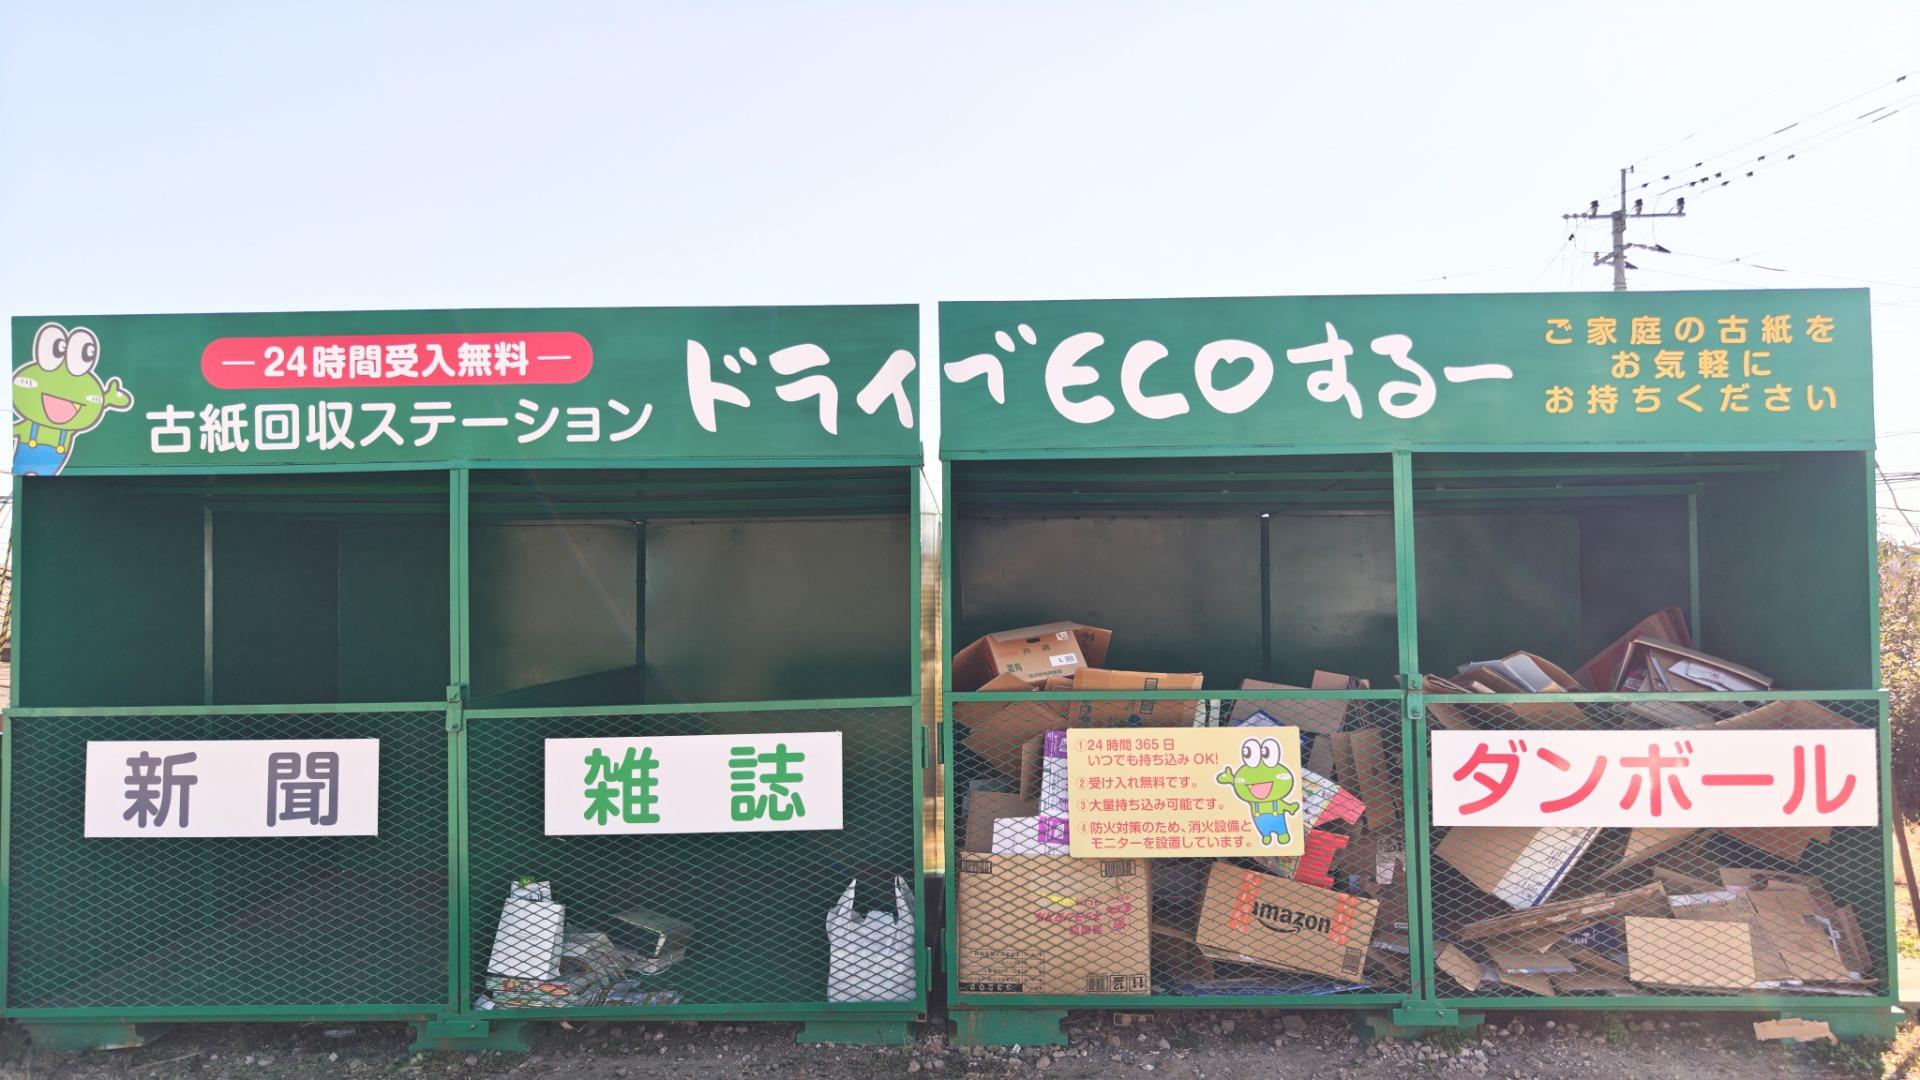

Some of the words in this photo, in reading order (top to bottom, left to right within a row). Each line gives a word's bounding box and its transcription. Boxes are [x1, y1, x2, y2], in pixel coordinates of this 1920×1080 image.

[1545, 314, 1835, 346] ご家庭の古紙を
[264, 341, 529, 379] 24時間受入無料
[1611, 349, 1772, 379] お気軽に
[1545, 383, 1837, 415] お持ちください
[146, 399, 653, 454] 古紙回収ステーション
[123, 751, 339, 828] 新聞
[583, 743, 806, 825] 雑誌
[1453, 740, 1857, 817] ダンボール
